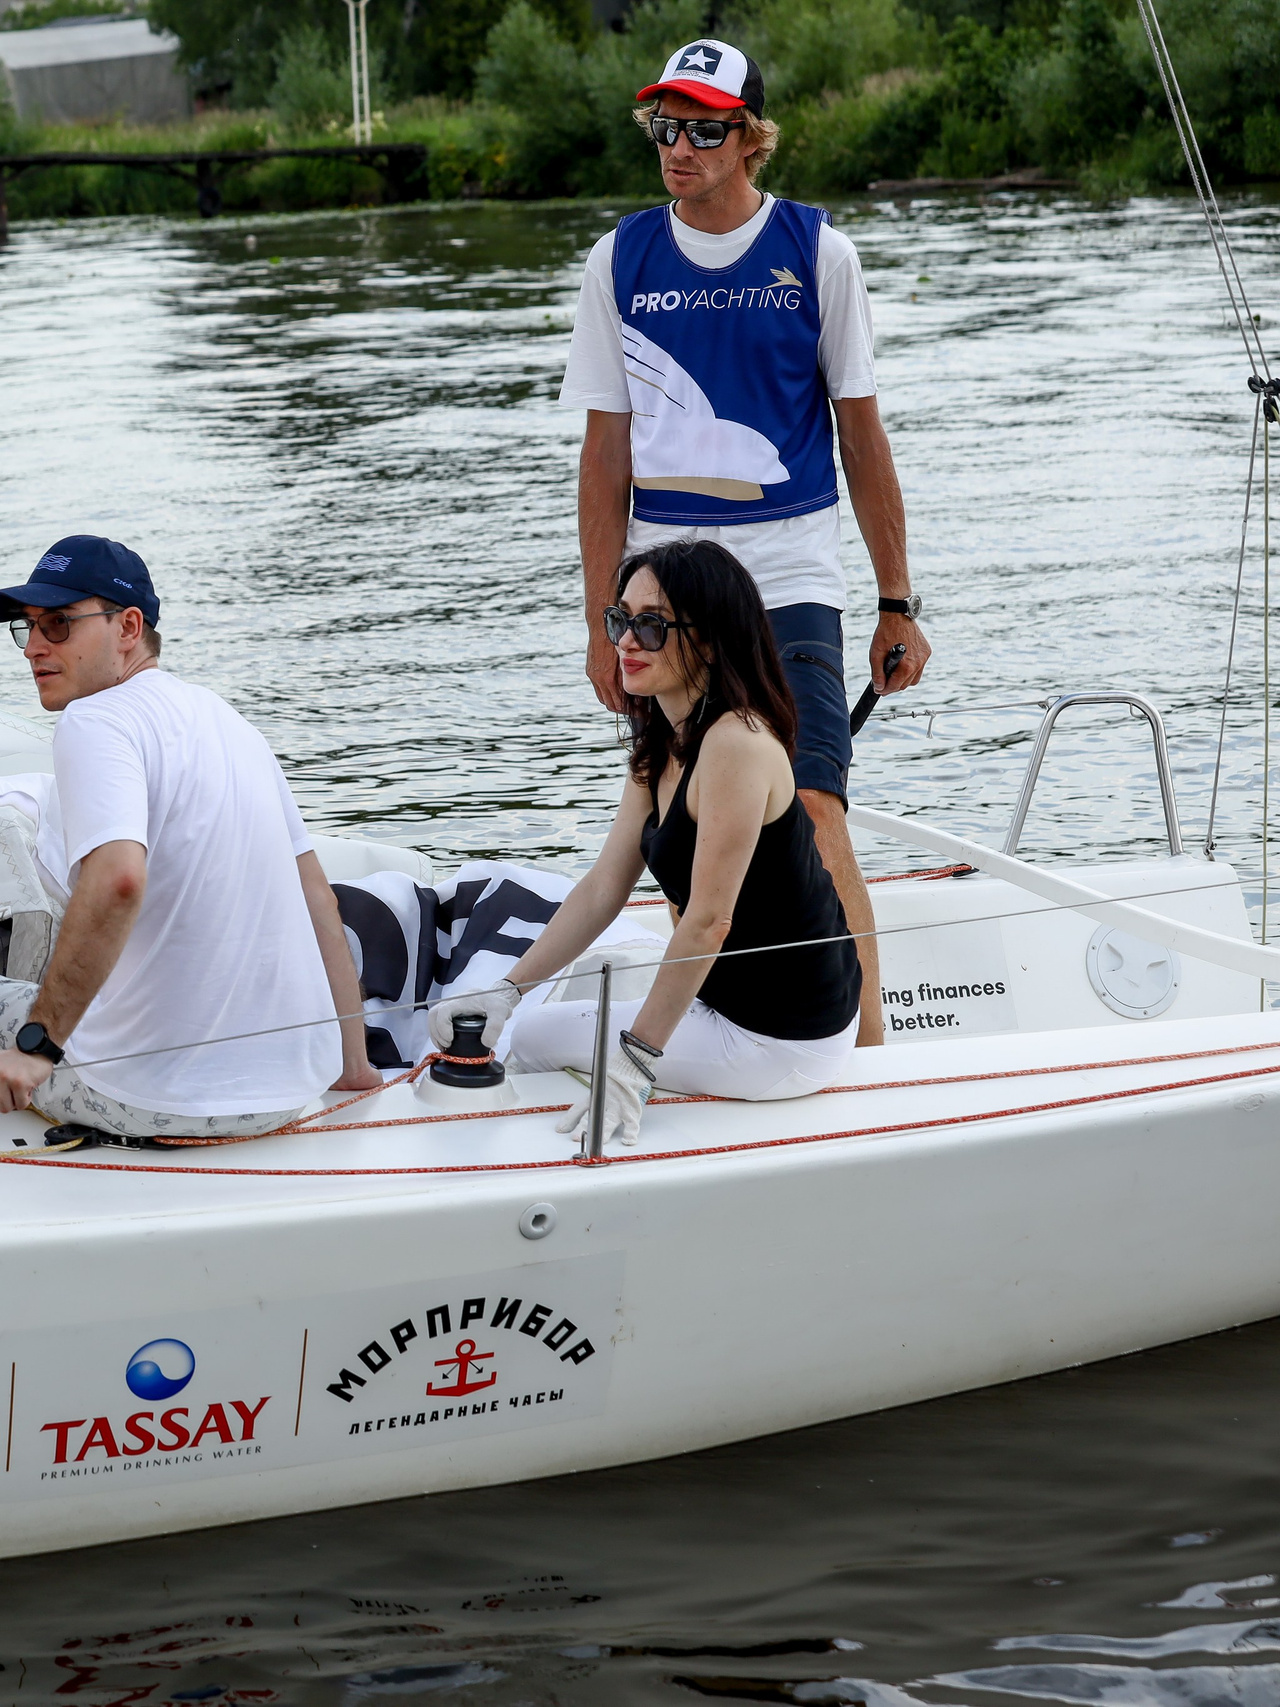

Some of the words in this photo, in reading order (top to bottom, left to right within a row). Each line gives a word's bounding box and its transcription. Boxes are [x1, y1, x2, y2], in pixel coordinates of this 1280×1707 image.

[630, 287, 802, 315] PROYACHTING
[881, 986, 914, 1007] ing
[918, 981, 1006, 1001] finances
[890, 1012, 961, 1031] better.
[326, 1297, 596, 1403] МОРПРИБОР
[348, 1400, 499, 1435] ЛЕГЕНДАРНЫЕ
[509, 1389, 564, 1408] ЧАСЫ
[40, 1396, 272, 1464] TASSAY
[40, 1465, 114, 1480] PREMIUM
[123, 1453, 204, 1471] DRINKING
[213, 1445, 262, 1459] WATER
